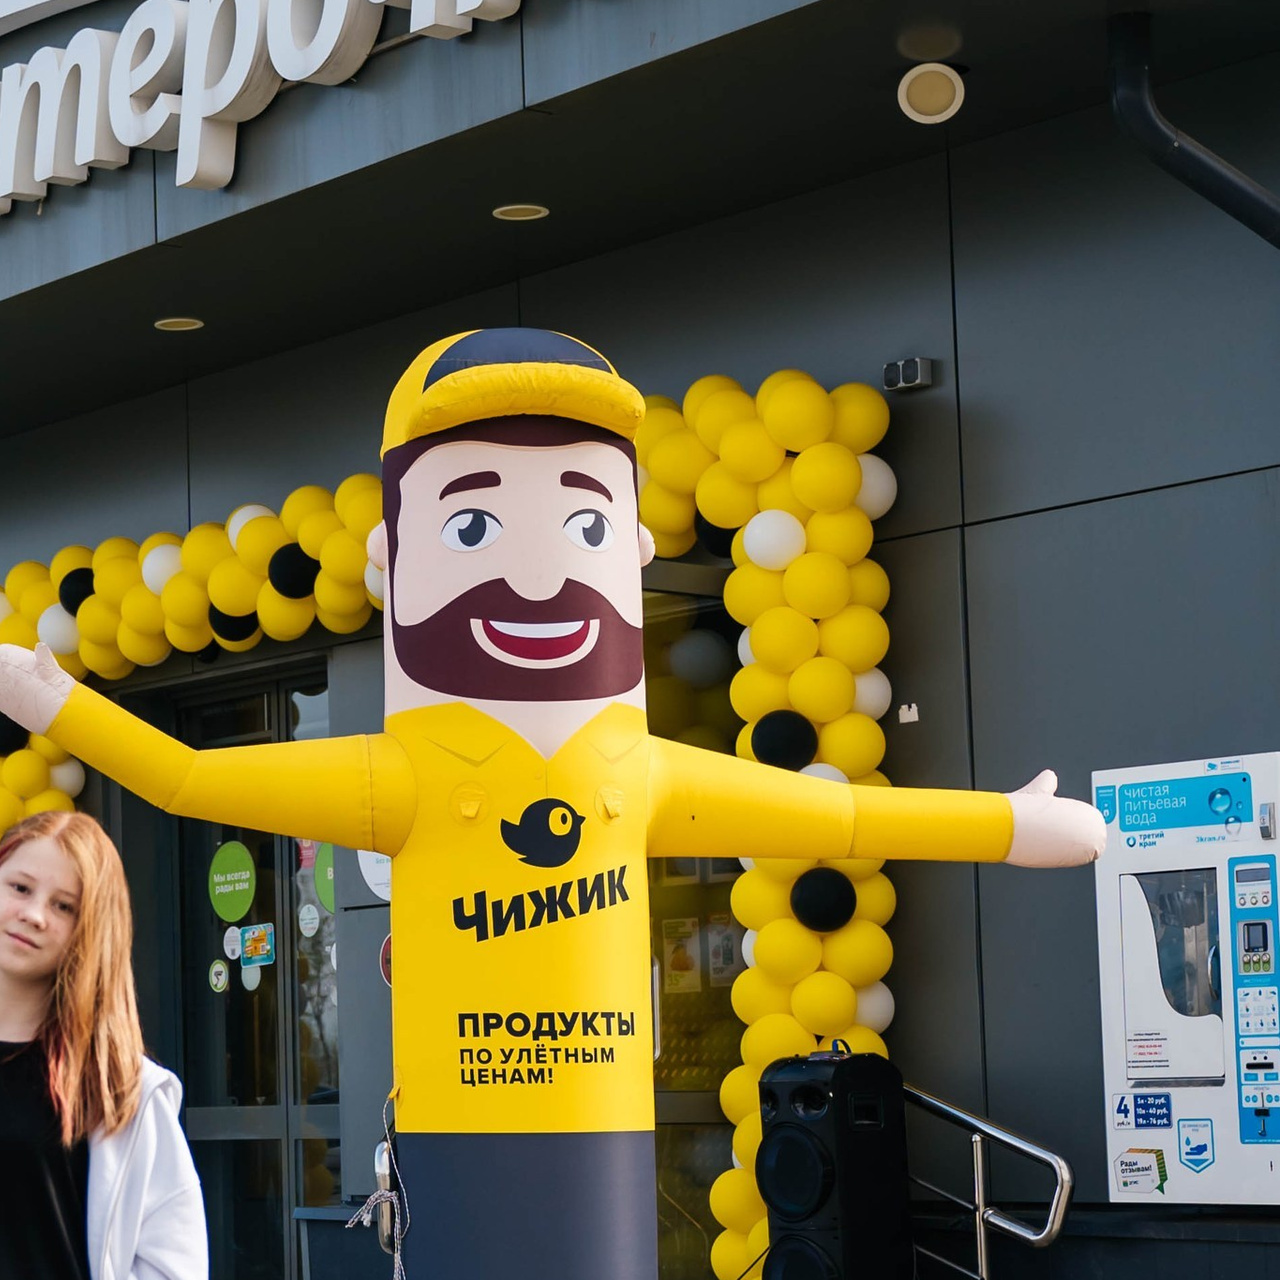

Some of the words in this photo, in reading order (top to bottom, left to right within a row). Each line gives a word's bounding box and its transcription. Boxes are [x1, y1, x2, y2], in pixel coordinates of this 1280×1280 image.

[1124, 784, 1170, 799] чистая
[1124, 796, 1187, 812] питьевая
[1125, 812, 1157, 826] вода
[1138, 831, 1165, 841] третий
[1138, 840, 1157, 849] кран
[213, 873, 226, 883] Мы
[226, 870, 251, 881] всегда
[215, 883, 234, 895] рады
[235, 881, 249, 891] вам
[457, 1011, 636, 1041] ПРОДУКТЫ
[459, 1047, 493, 1064] ПО
[500, 1043, 615, 1064] УЛЁТНЫМ
[460, 1067, 554, 1088] ЦЕНАМ!
[1116, 1095, 1130, 1118] 4
[1155, 1097, 1167, 1105] руб.
[1149, 1107, 1156, 1115] 40
[1156, 1107, 1169, 1116] руб.
[1149, 1117, 1157, 1125] 76
[1157, 1117, 1169, 1126] руб.
[1120, 1160, 1138, 1168] Рады
[1120, 1164, 1152, 1175] отзывам!
